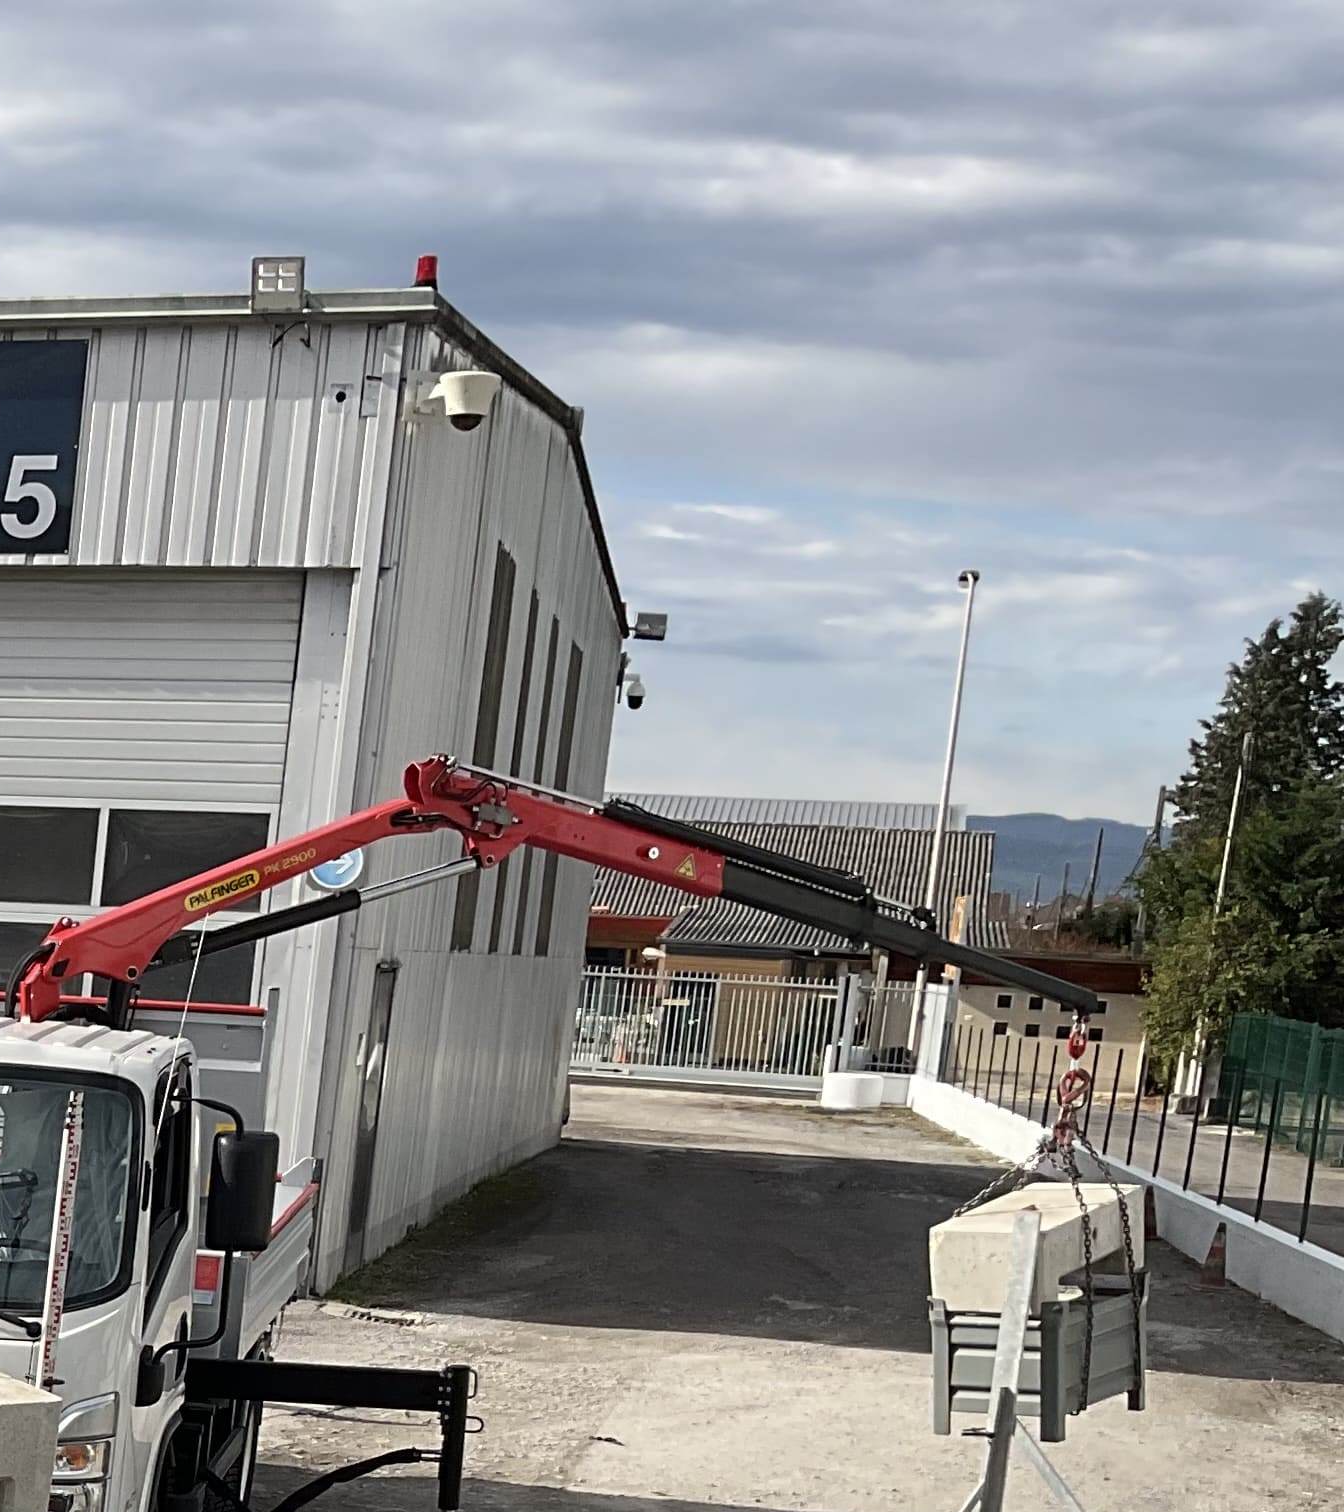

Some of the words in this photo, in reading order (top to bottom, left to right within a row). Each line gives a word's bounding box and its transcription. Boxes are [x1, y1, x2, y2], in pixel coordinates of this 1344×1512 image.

[0, 454, 58, 539] 5
[283, 848, 316, 870] 2900
[189, 872, 256, 908] PALFINGER
